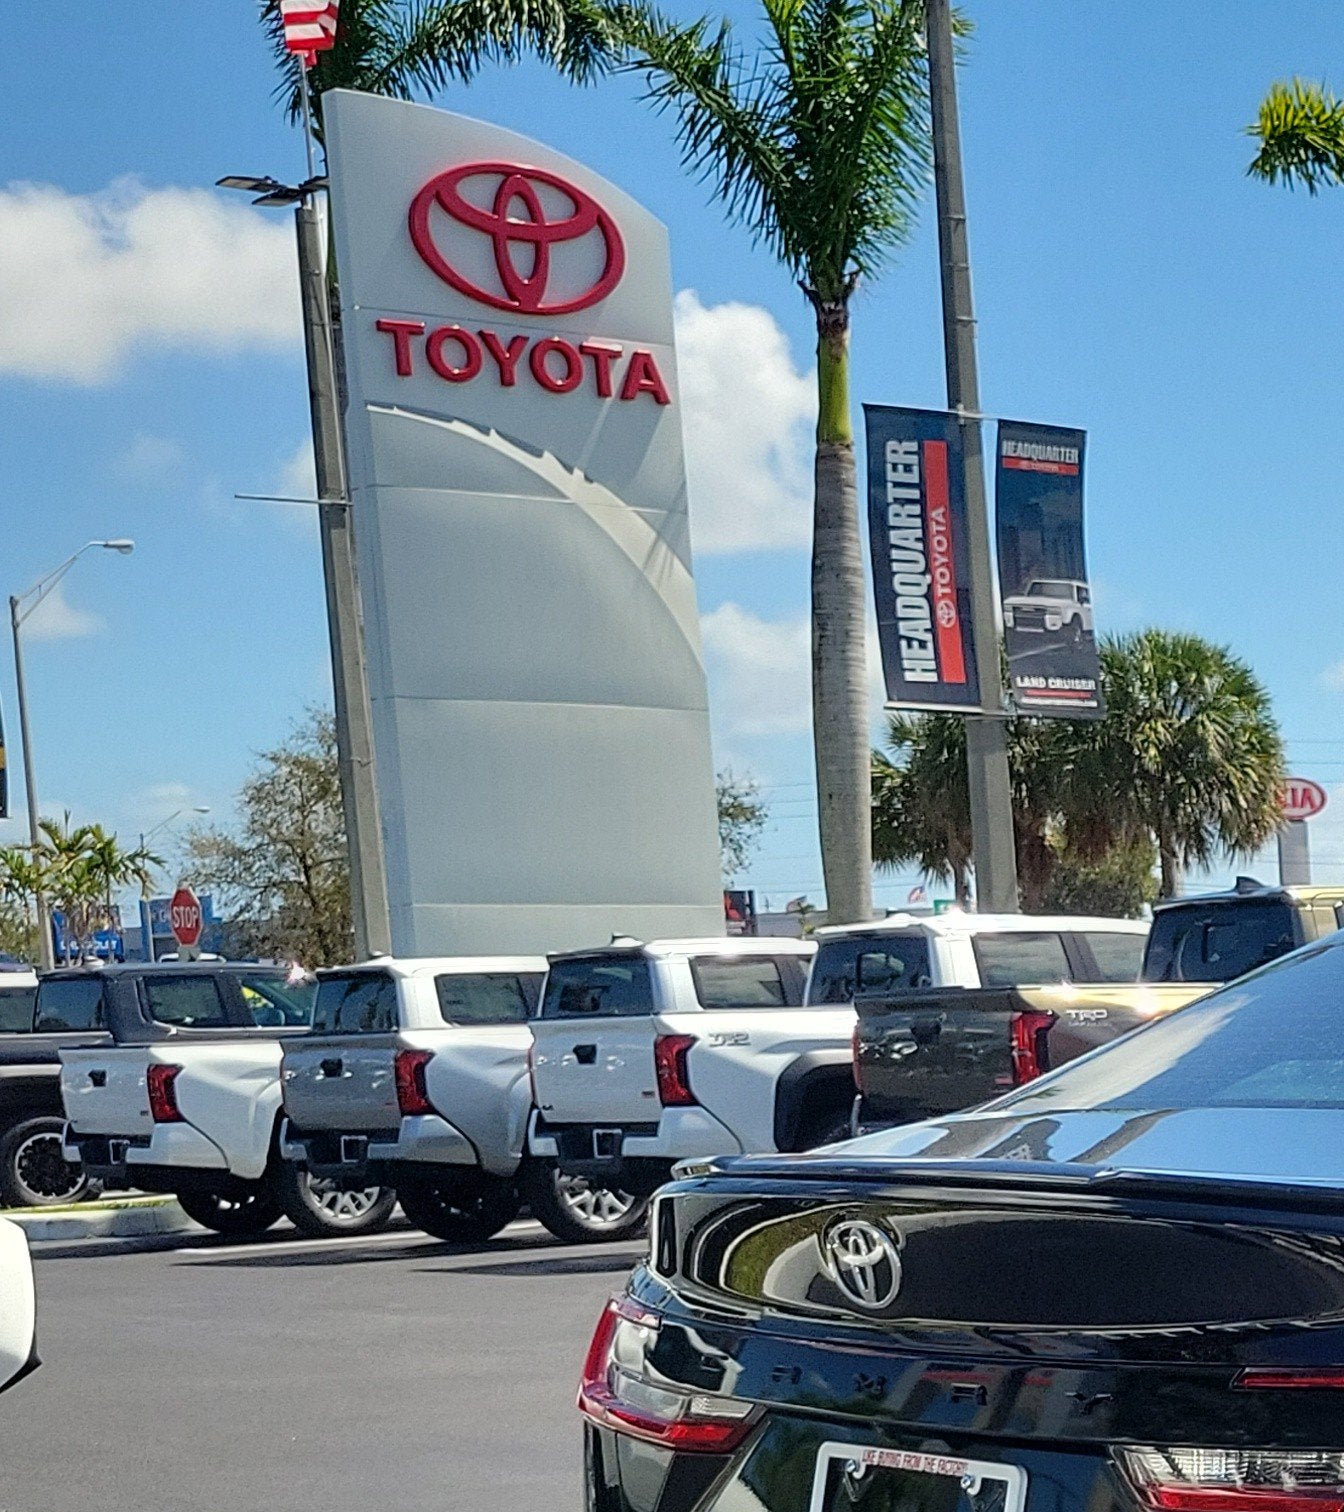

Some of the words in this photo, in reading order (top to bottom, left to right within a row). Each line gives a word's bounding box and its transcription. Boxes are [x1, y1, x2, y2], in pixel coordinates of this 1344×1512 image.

[376, 319, 670, 405] TOYOTA
[1002, 440, 1078, 464] HEADQUARTER
[885, 439, 939, 683] HEADQUARTER
[929, 506, 956, 597] TOYOTA
[1016, 676, 1046, 688] LAND
[1048, 678, 1096, 690] CRUISER
[172, 907, 198, 928] STOP
[1066, 1009, 1107, 1021] TRD
